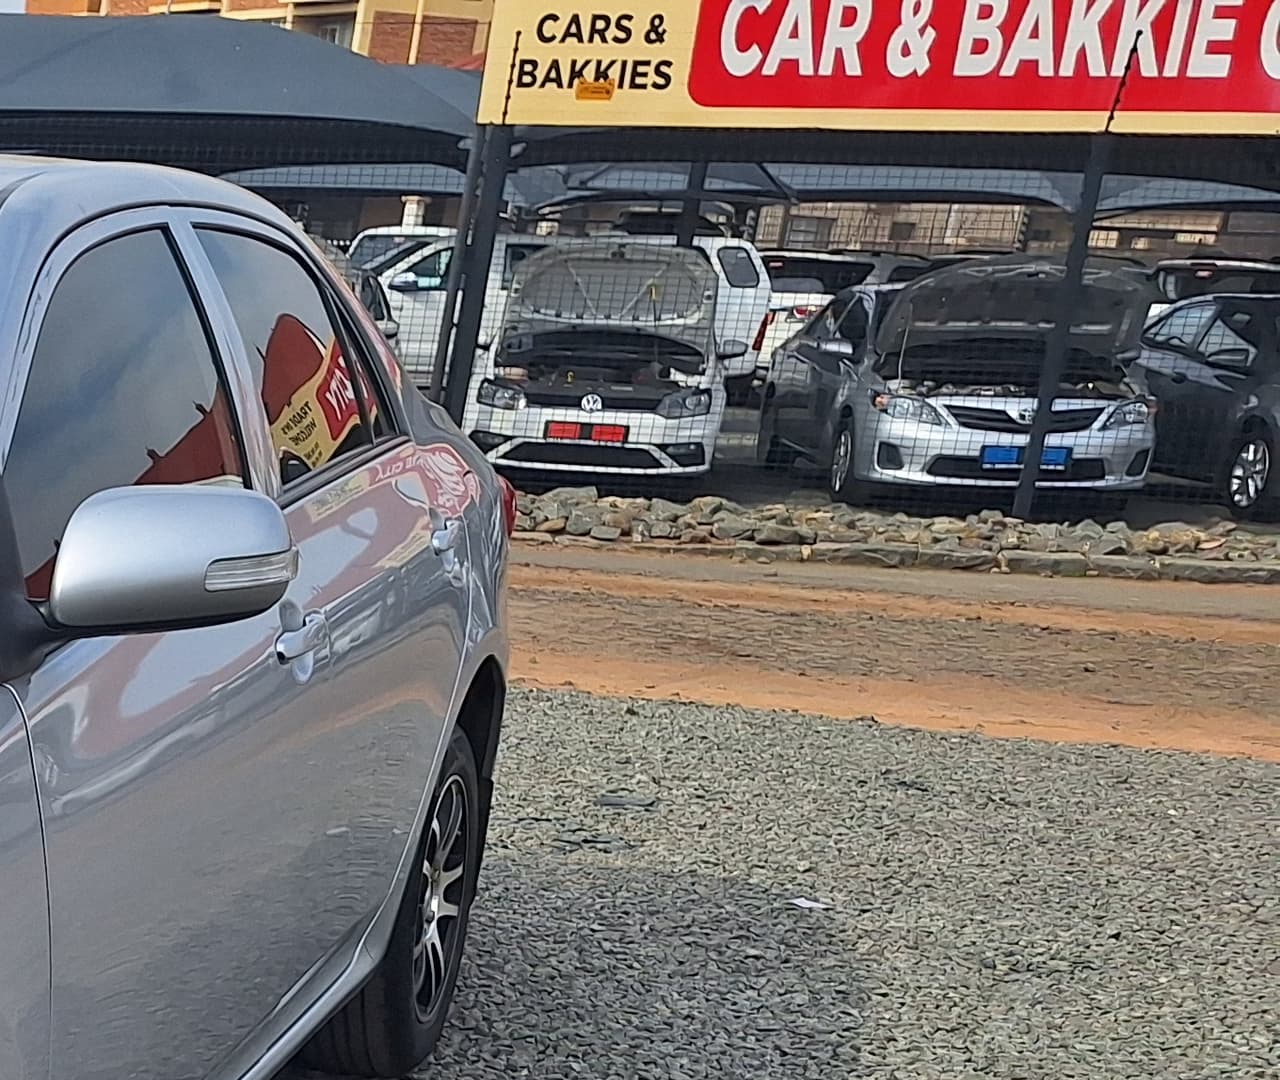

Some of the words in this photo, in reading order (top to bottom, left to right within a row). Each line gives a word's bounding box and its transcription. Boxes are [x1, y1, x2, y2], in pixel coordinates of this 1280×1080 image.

[536, 13, 635, 44] CARS
[643, 13, 667, 45] &
[720, 0, 872, 77] CAR
[886, 0, 937, 78] &
[953, 0, 1238, 78] BAKKIE
[516, 59, 674, 90] BAKKIES
